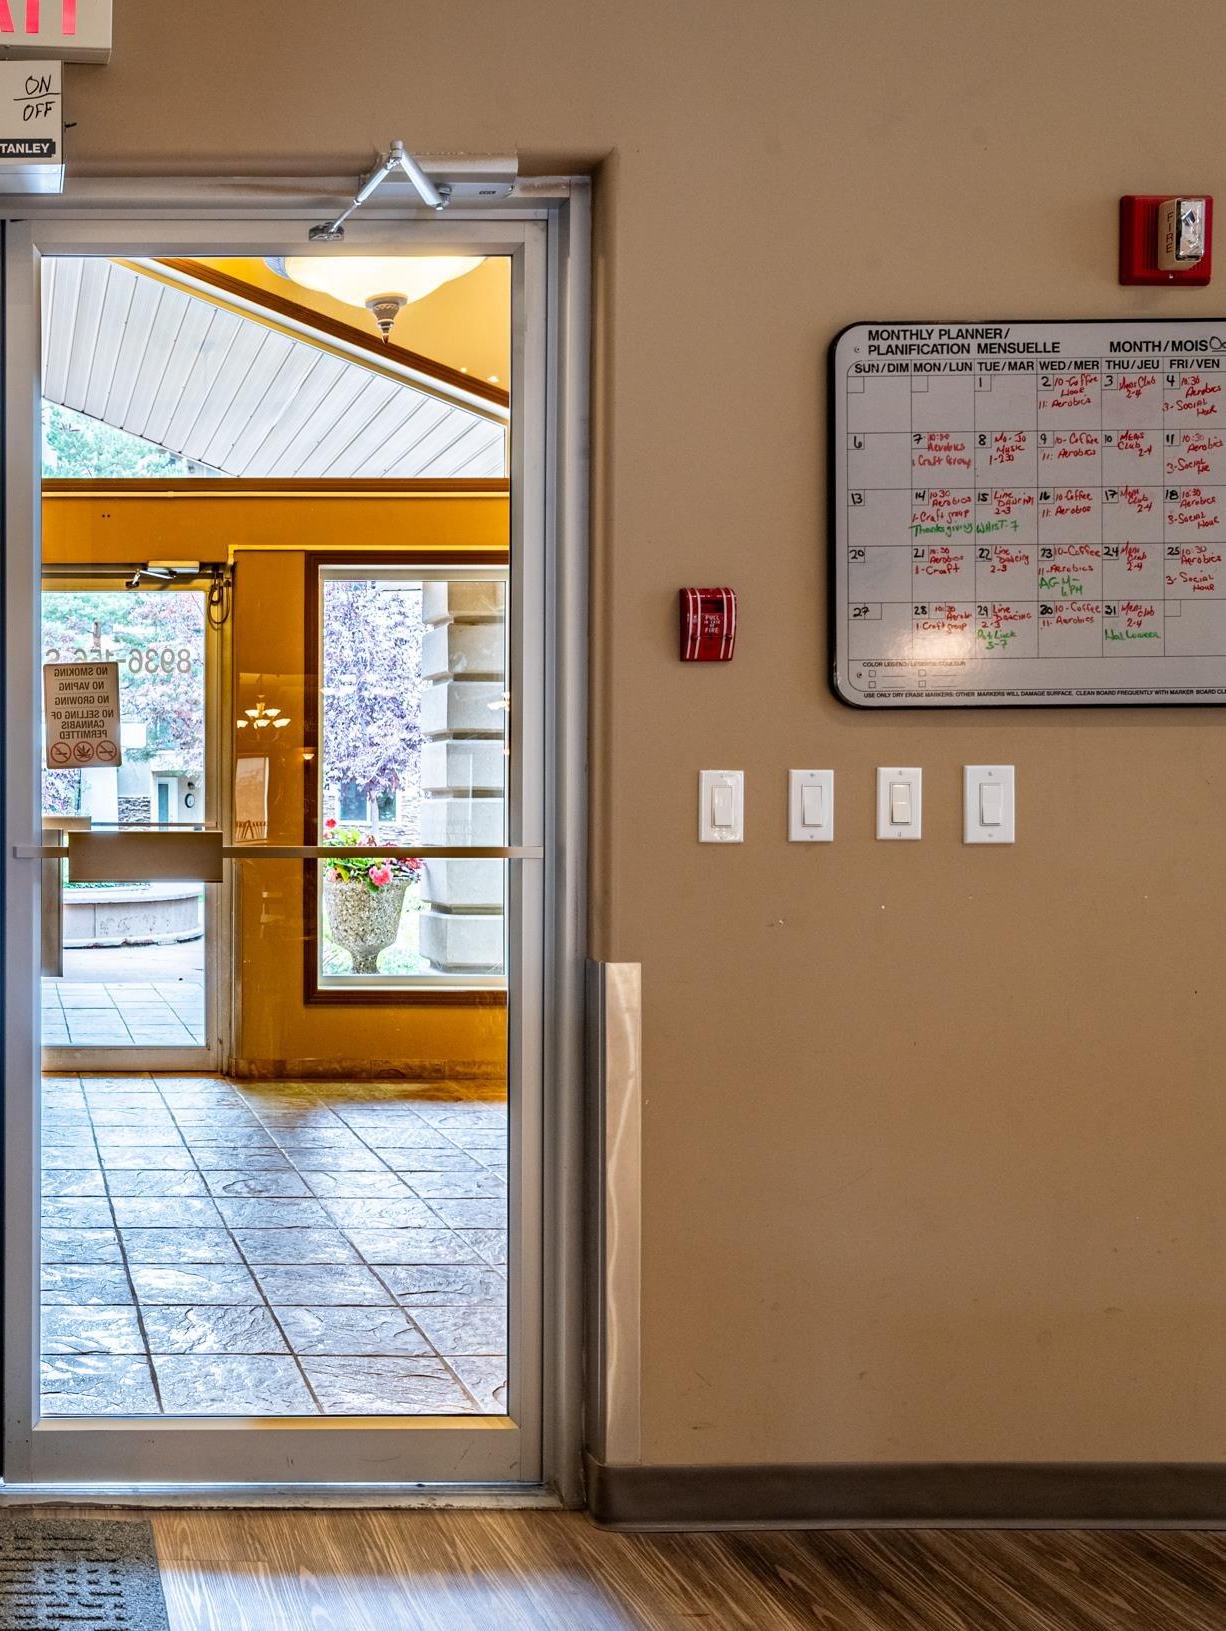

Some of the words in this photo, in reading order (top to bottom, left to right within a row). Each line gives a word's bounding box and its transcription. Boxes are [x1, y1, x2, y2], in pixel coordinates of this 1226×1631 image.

[25, 75, 51, 94] ON
[23, 101, 55, 121] OFF
[868, 329, 934, 341] MONTHLY
[939, 328, 1010, 340] PLANNER/
[868, 343, 970, 355] PLANIFICATION
[977, 341, 1060, 354] MENSUELLE
[851, 493, 862, 503] 13
[849, 550, 865, 559] 20
